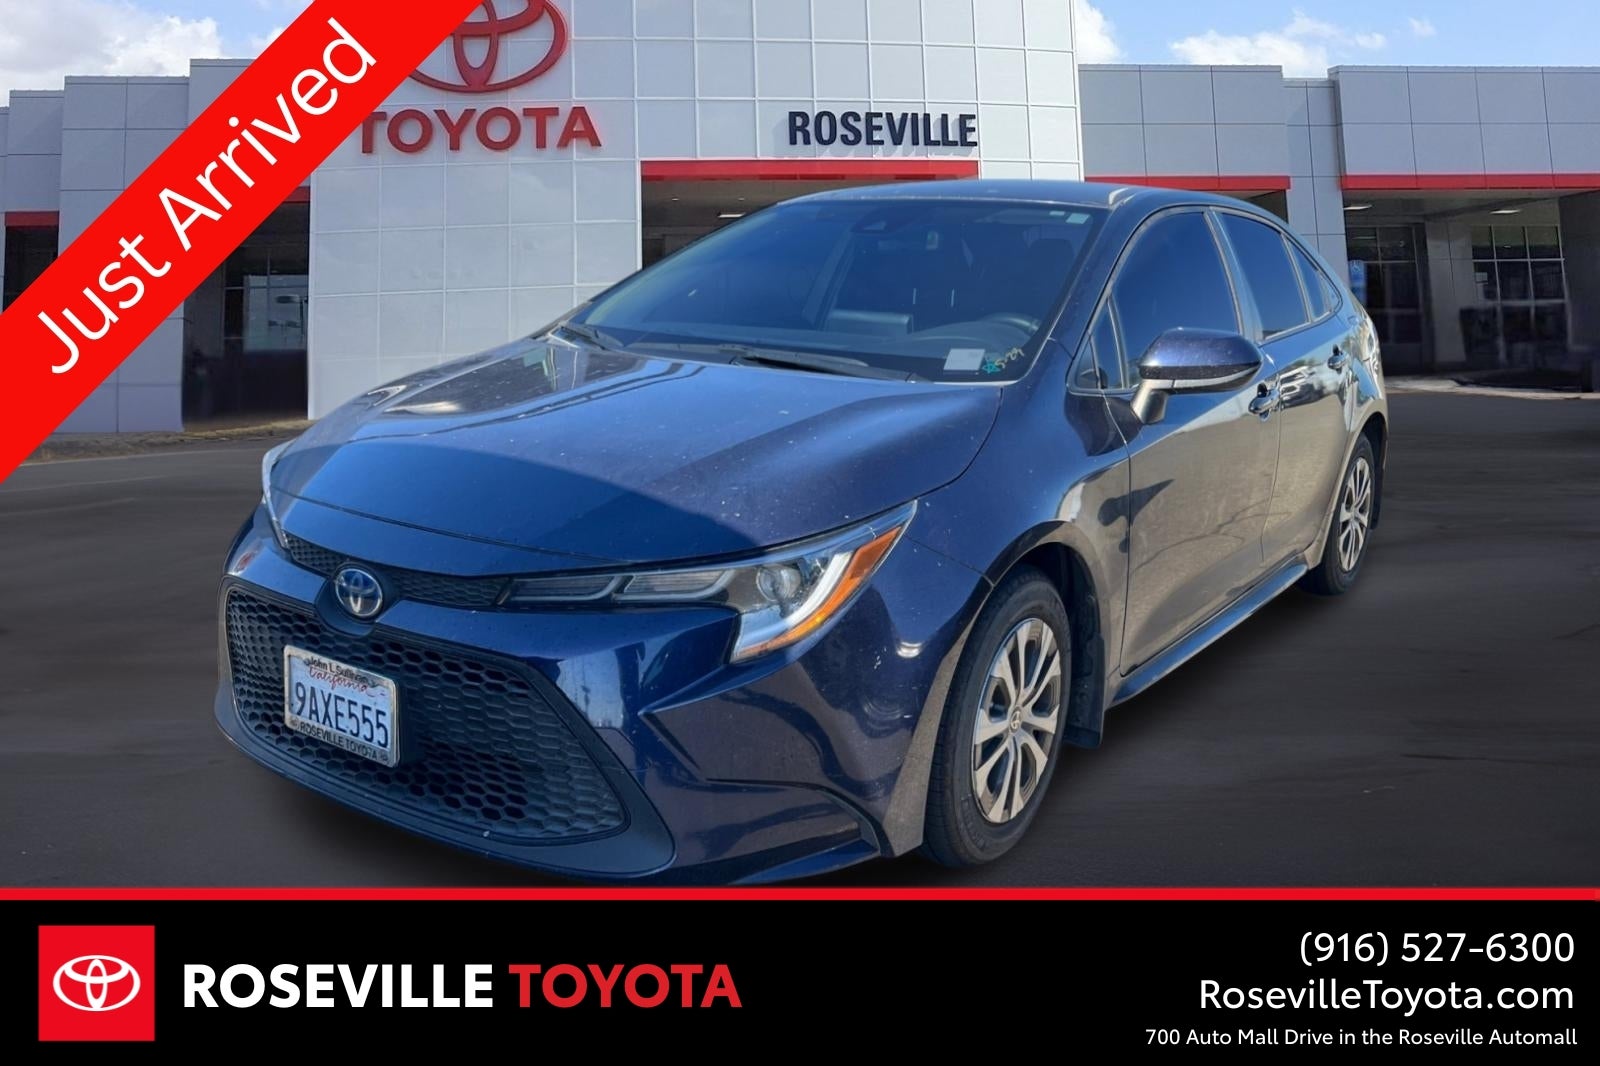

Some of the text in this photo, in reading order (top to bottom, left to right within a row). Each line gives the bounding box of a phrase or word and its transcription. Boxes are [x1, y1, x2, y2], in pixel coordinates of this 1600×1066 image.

[361, 106, 602, 154] TOYOTA
[788, 110, 978, 147] ROSEVILLE
[309, 666, 368, 692] California
[295, 681, 388, 749] 9AXE555
[300, 721, 377, 758] ROSEVILLE TOYOTA
